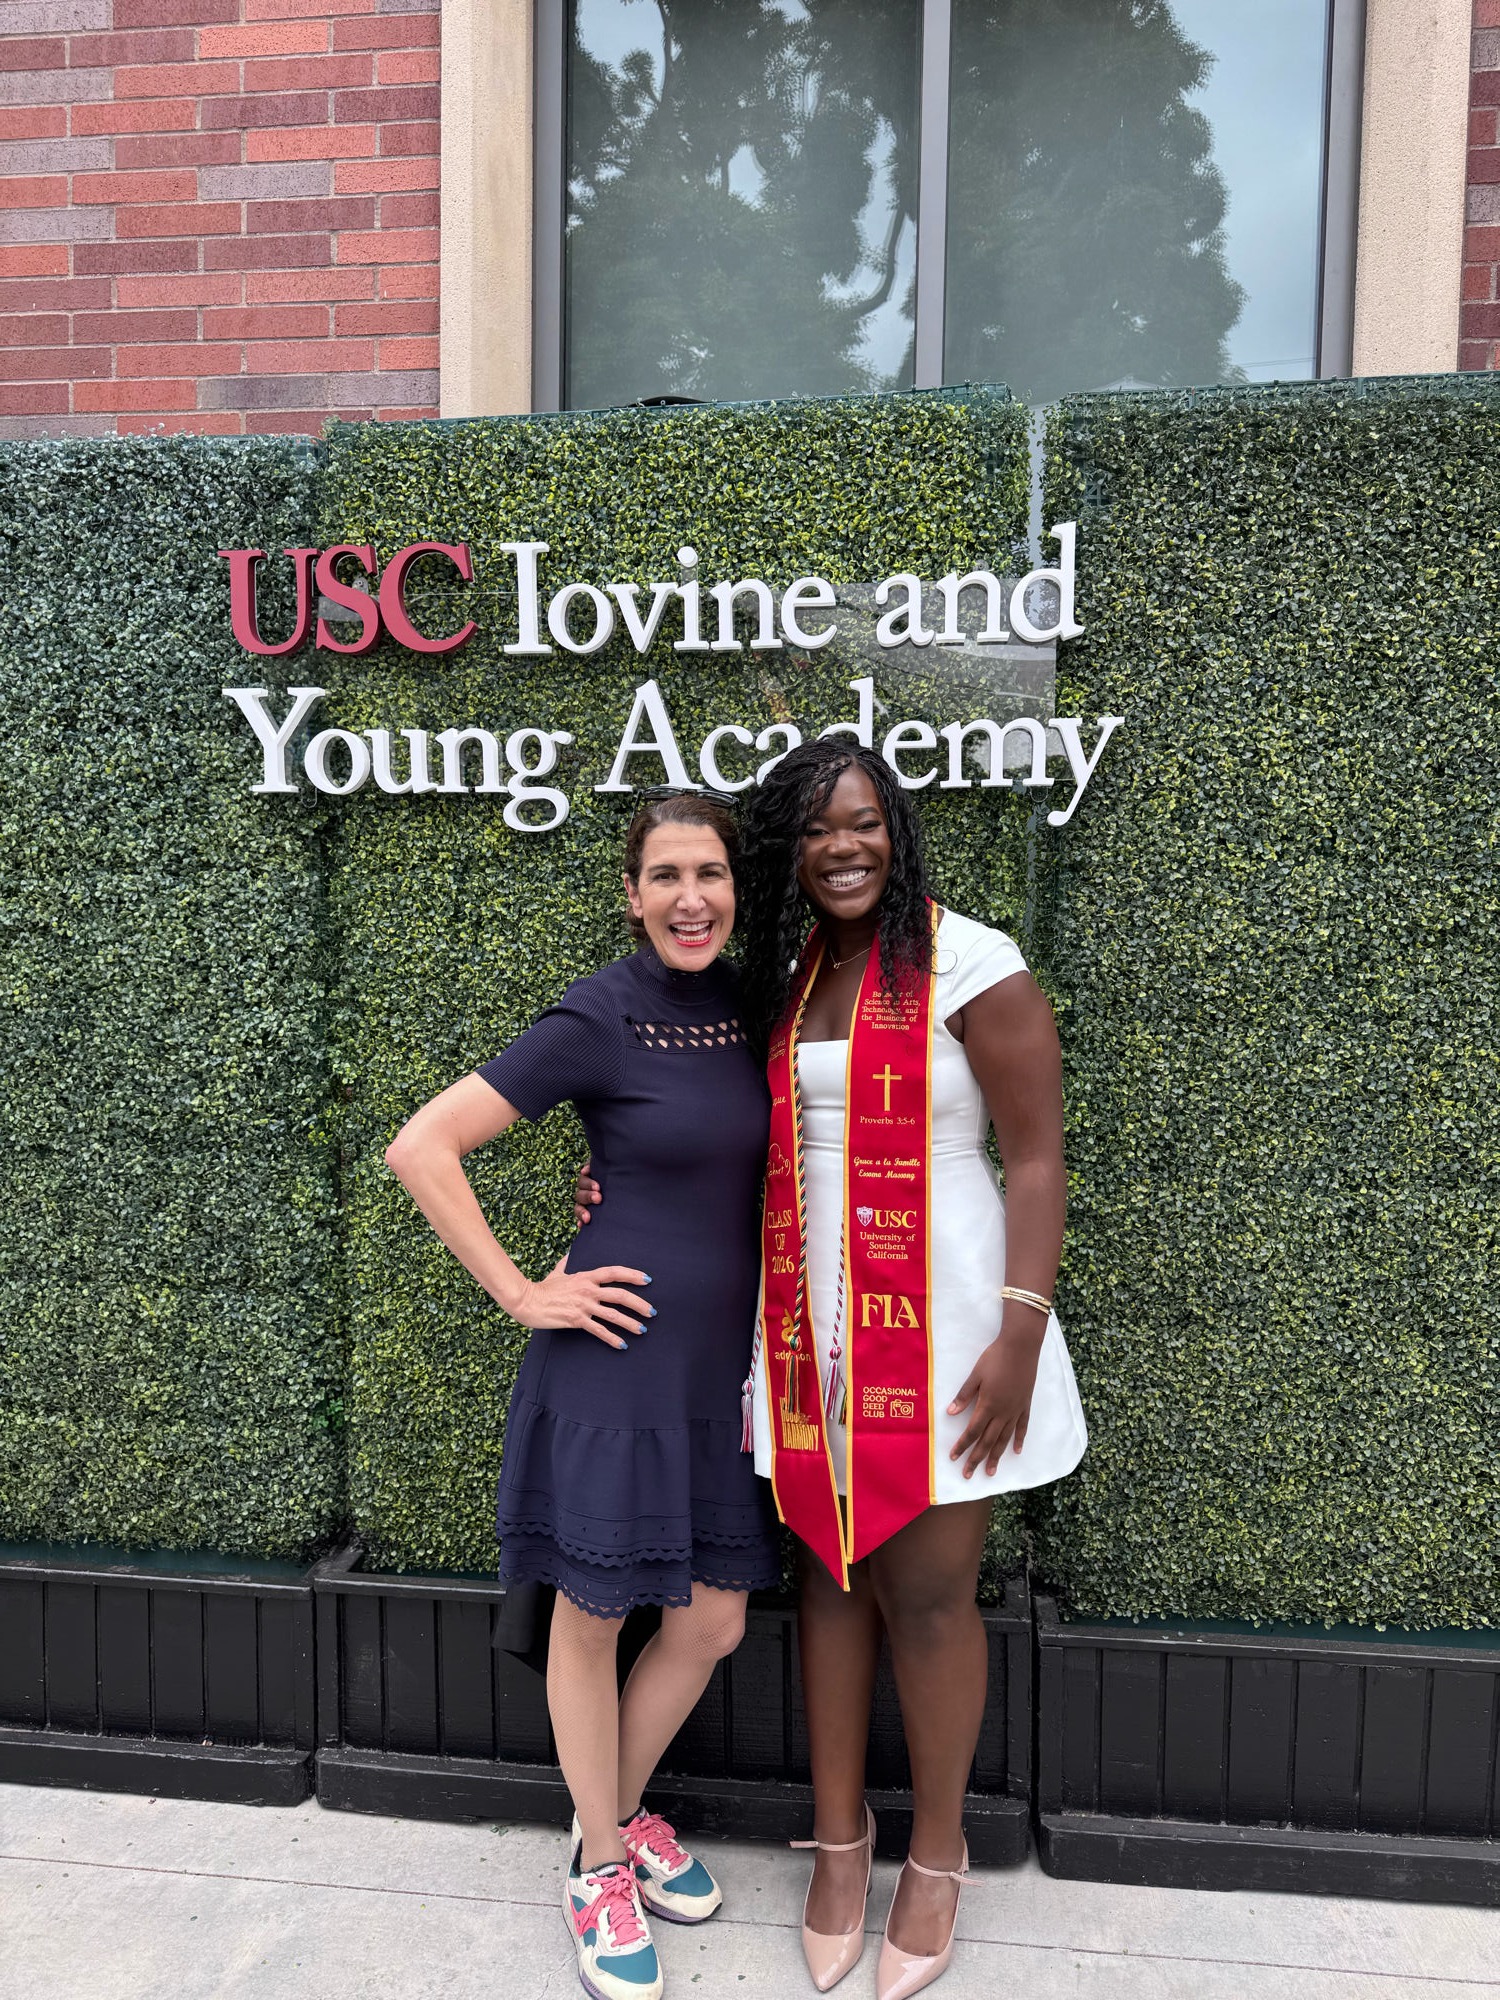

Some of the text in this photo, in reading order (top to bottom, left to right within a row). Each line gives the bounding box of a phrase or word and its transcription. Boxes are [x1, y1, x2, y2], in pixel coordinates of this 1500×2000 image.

[218, 521, 1086, 656] USC Iovine and
[221, 687, 575, 833] Young
[902, 999, 921, 1007] Arts,
[861, 1013, 918, 1022] the Business of
[871, 1021, 910, 1031] Innovation
[859, 1115, 916, 1125] Proverbs 3:5-6
[883, 1157, 892, 1166] la
[893, 1157, 921, 1167] Famille
[767, 1209, 792, 1229] CLASS
[873, 1209, 917, 1229] USC
[775, 1233, 786, 1251] OF
[859, 1231, 916, 1243] University of
[869, 1241, 906, 1251] Southern
[866, 1250, 909, 1260] California
[771, 1254, 795, 1274] 2026
[860, 1292, 921, 1329] FIA
[862, 1386, 918, 1396] OCCASIONAL
[862, 1402, 885, 1410] DEED
[862, 1410, 885, 1418] CLUB
[782, 1422, 819, 1452] HARMONY
